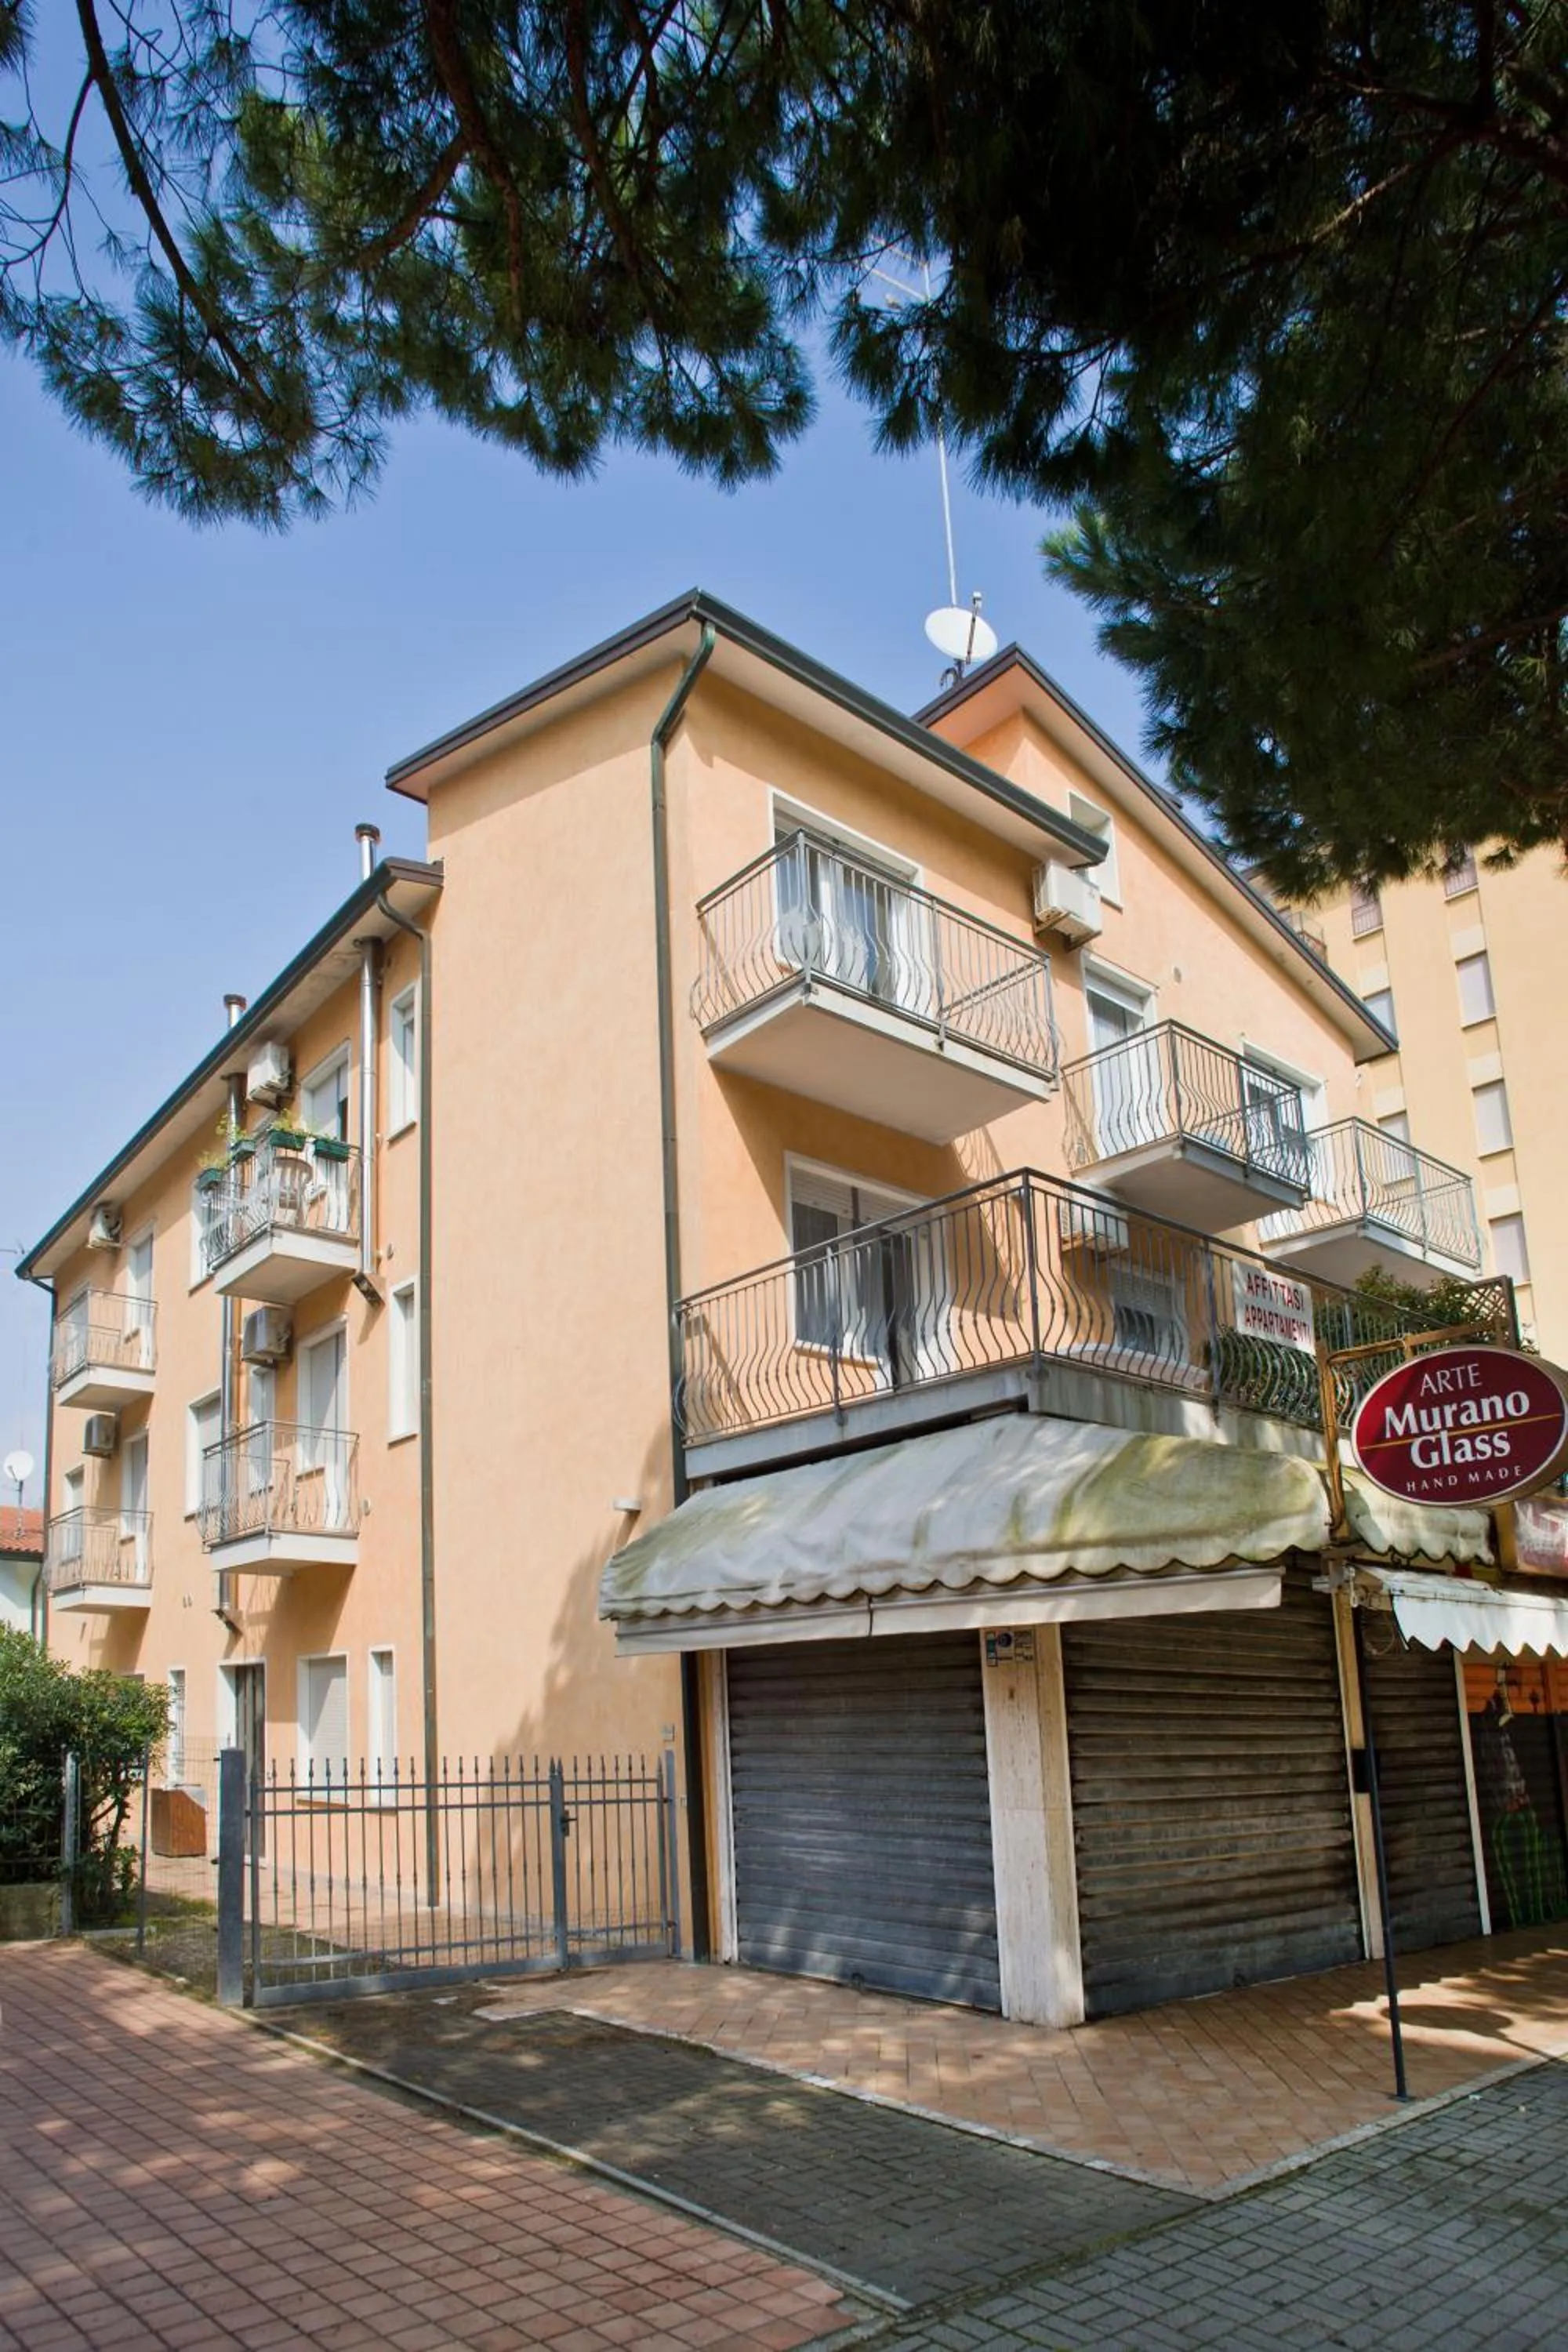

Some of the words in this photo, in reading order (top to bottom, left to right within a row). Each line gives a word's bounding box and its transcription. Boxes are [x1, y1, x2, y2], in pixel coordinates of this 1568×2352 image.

[1246, 1272, 1305, 1312] AFFITTASI
[1244, 1304, 1312, 1345] APPARTAMENTI
[1420, 1363, 1483, 1397] ARTE
[1385, 1391, 1530, 1439] Murano
[1410, 1430, 1511, 1469] Glass
[1406, 1475, 1458, 1493] HAND
[1468, 1465, 1523, 1483] MADE
